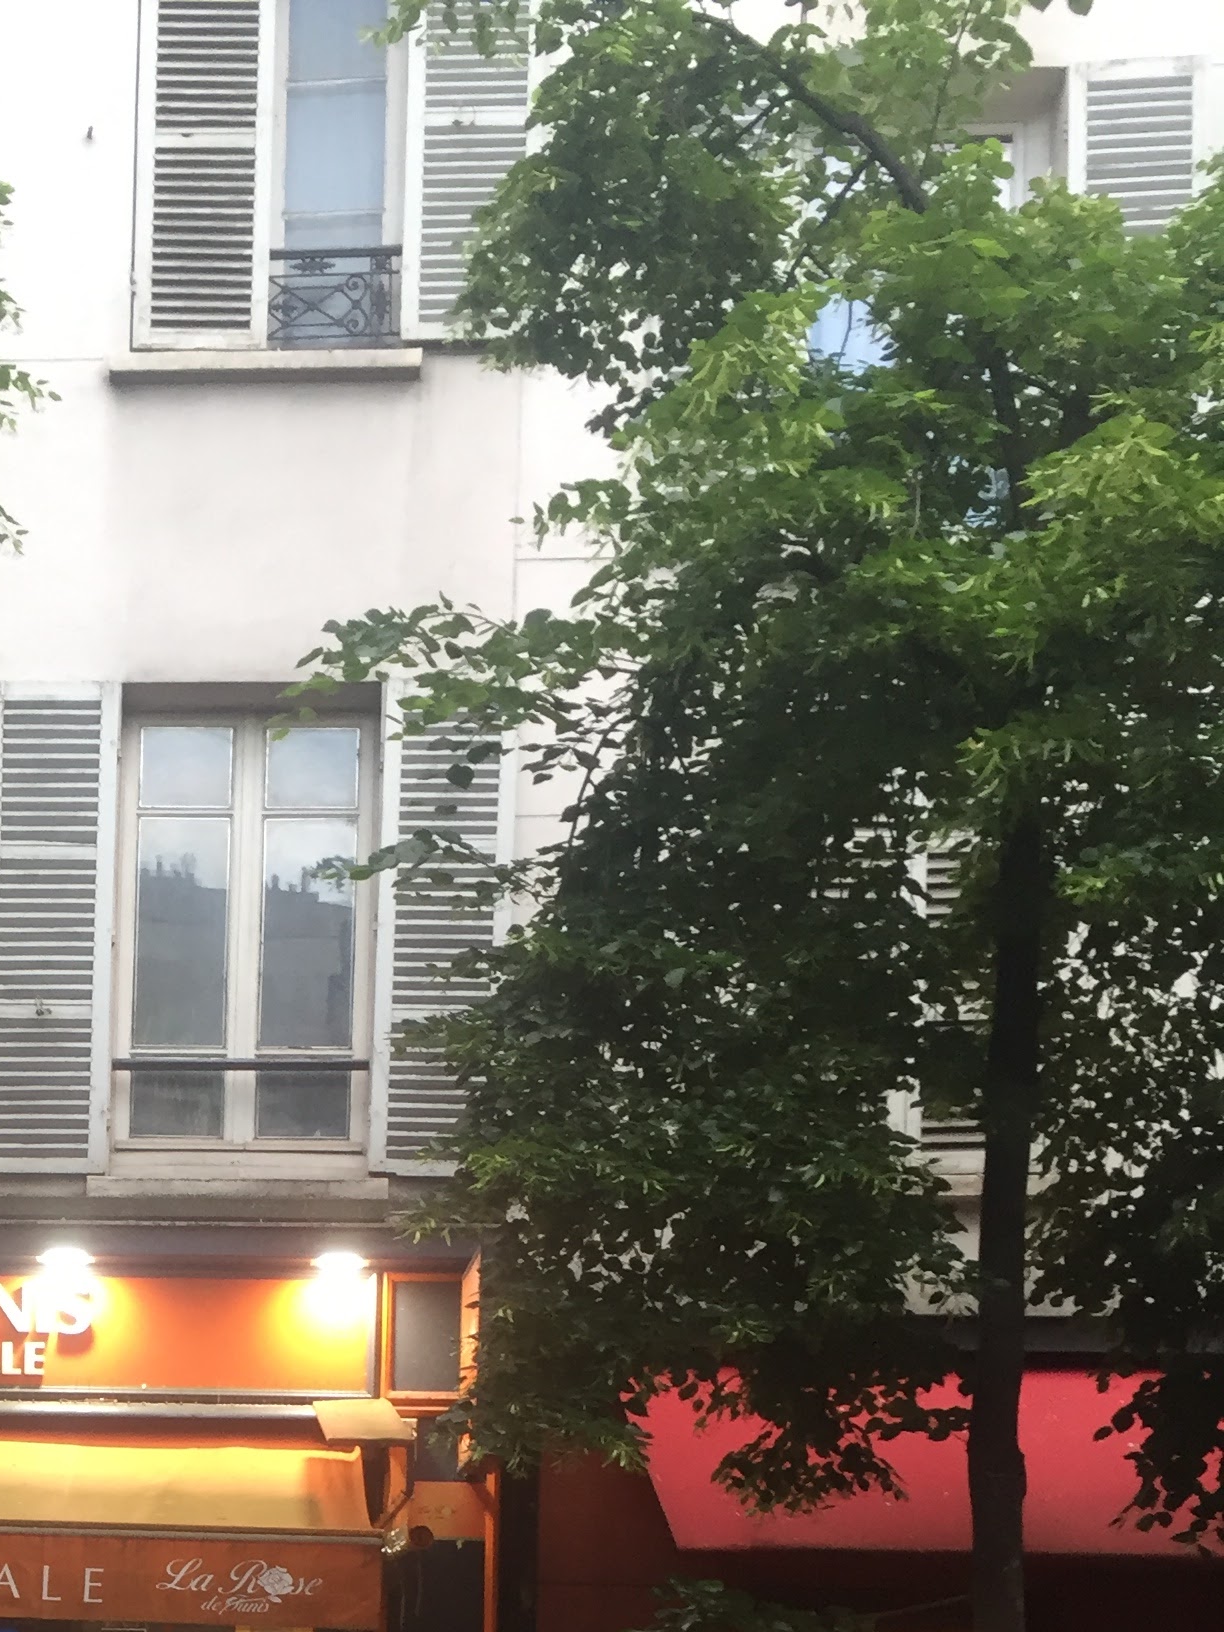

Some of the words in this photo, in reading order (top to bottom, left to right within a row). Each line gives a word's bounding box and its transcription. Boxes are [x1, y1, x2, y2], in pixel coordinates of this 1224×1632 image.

[155, 1558, 214, 1592] La
[217, 1559, 324, 1602] Rose
[200, 1595, 219, 1611] de
